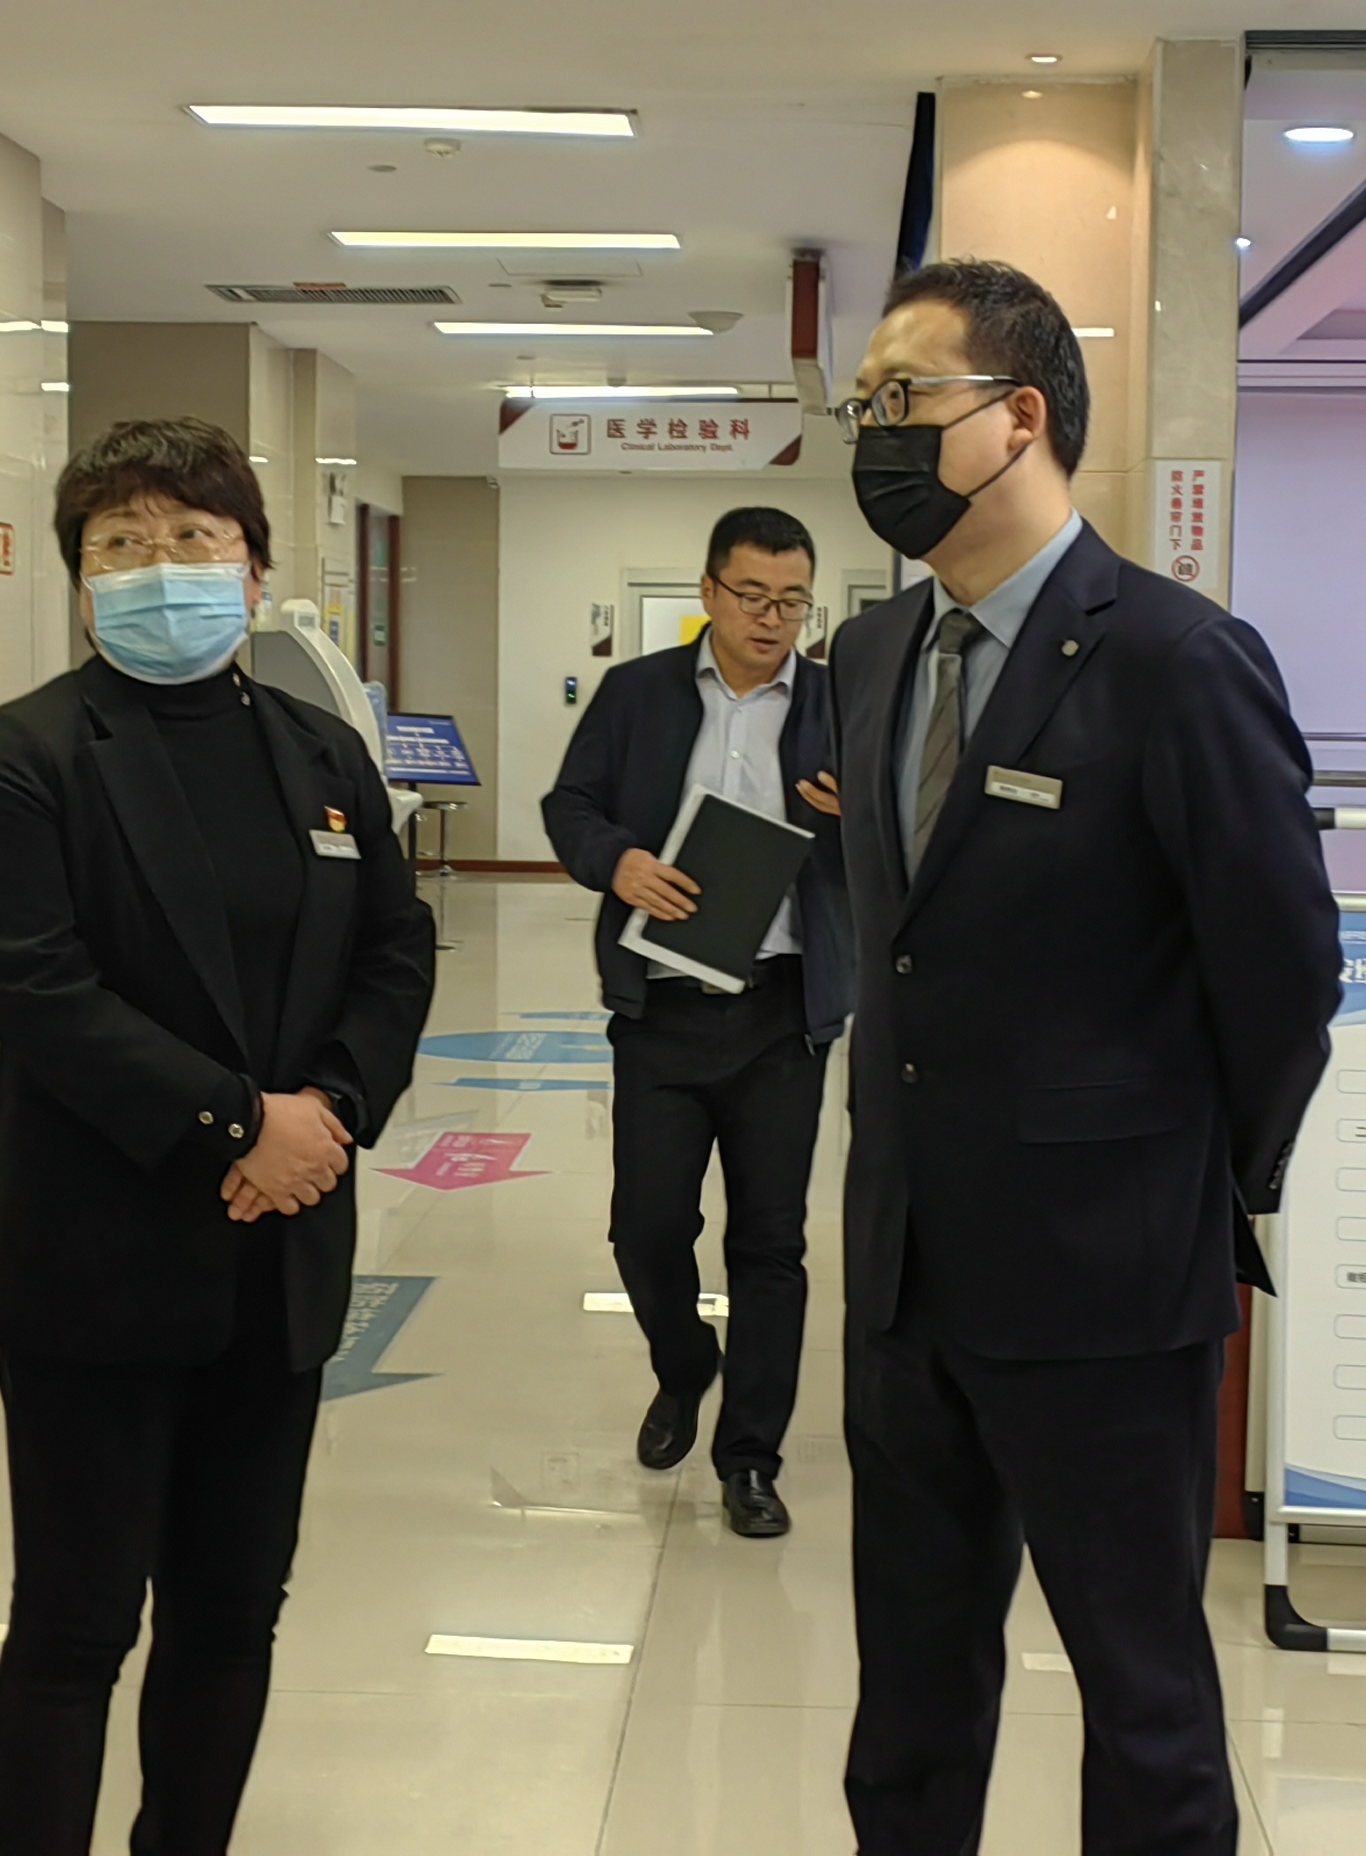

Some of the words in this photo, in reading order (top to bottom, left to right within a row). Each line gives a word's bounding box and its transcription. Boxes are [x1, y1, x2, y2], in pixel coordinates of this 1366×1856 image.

[607, 418, 749, 440] 医学检验科
